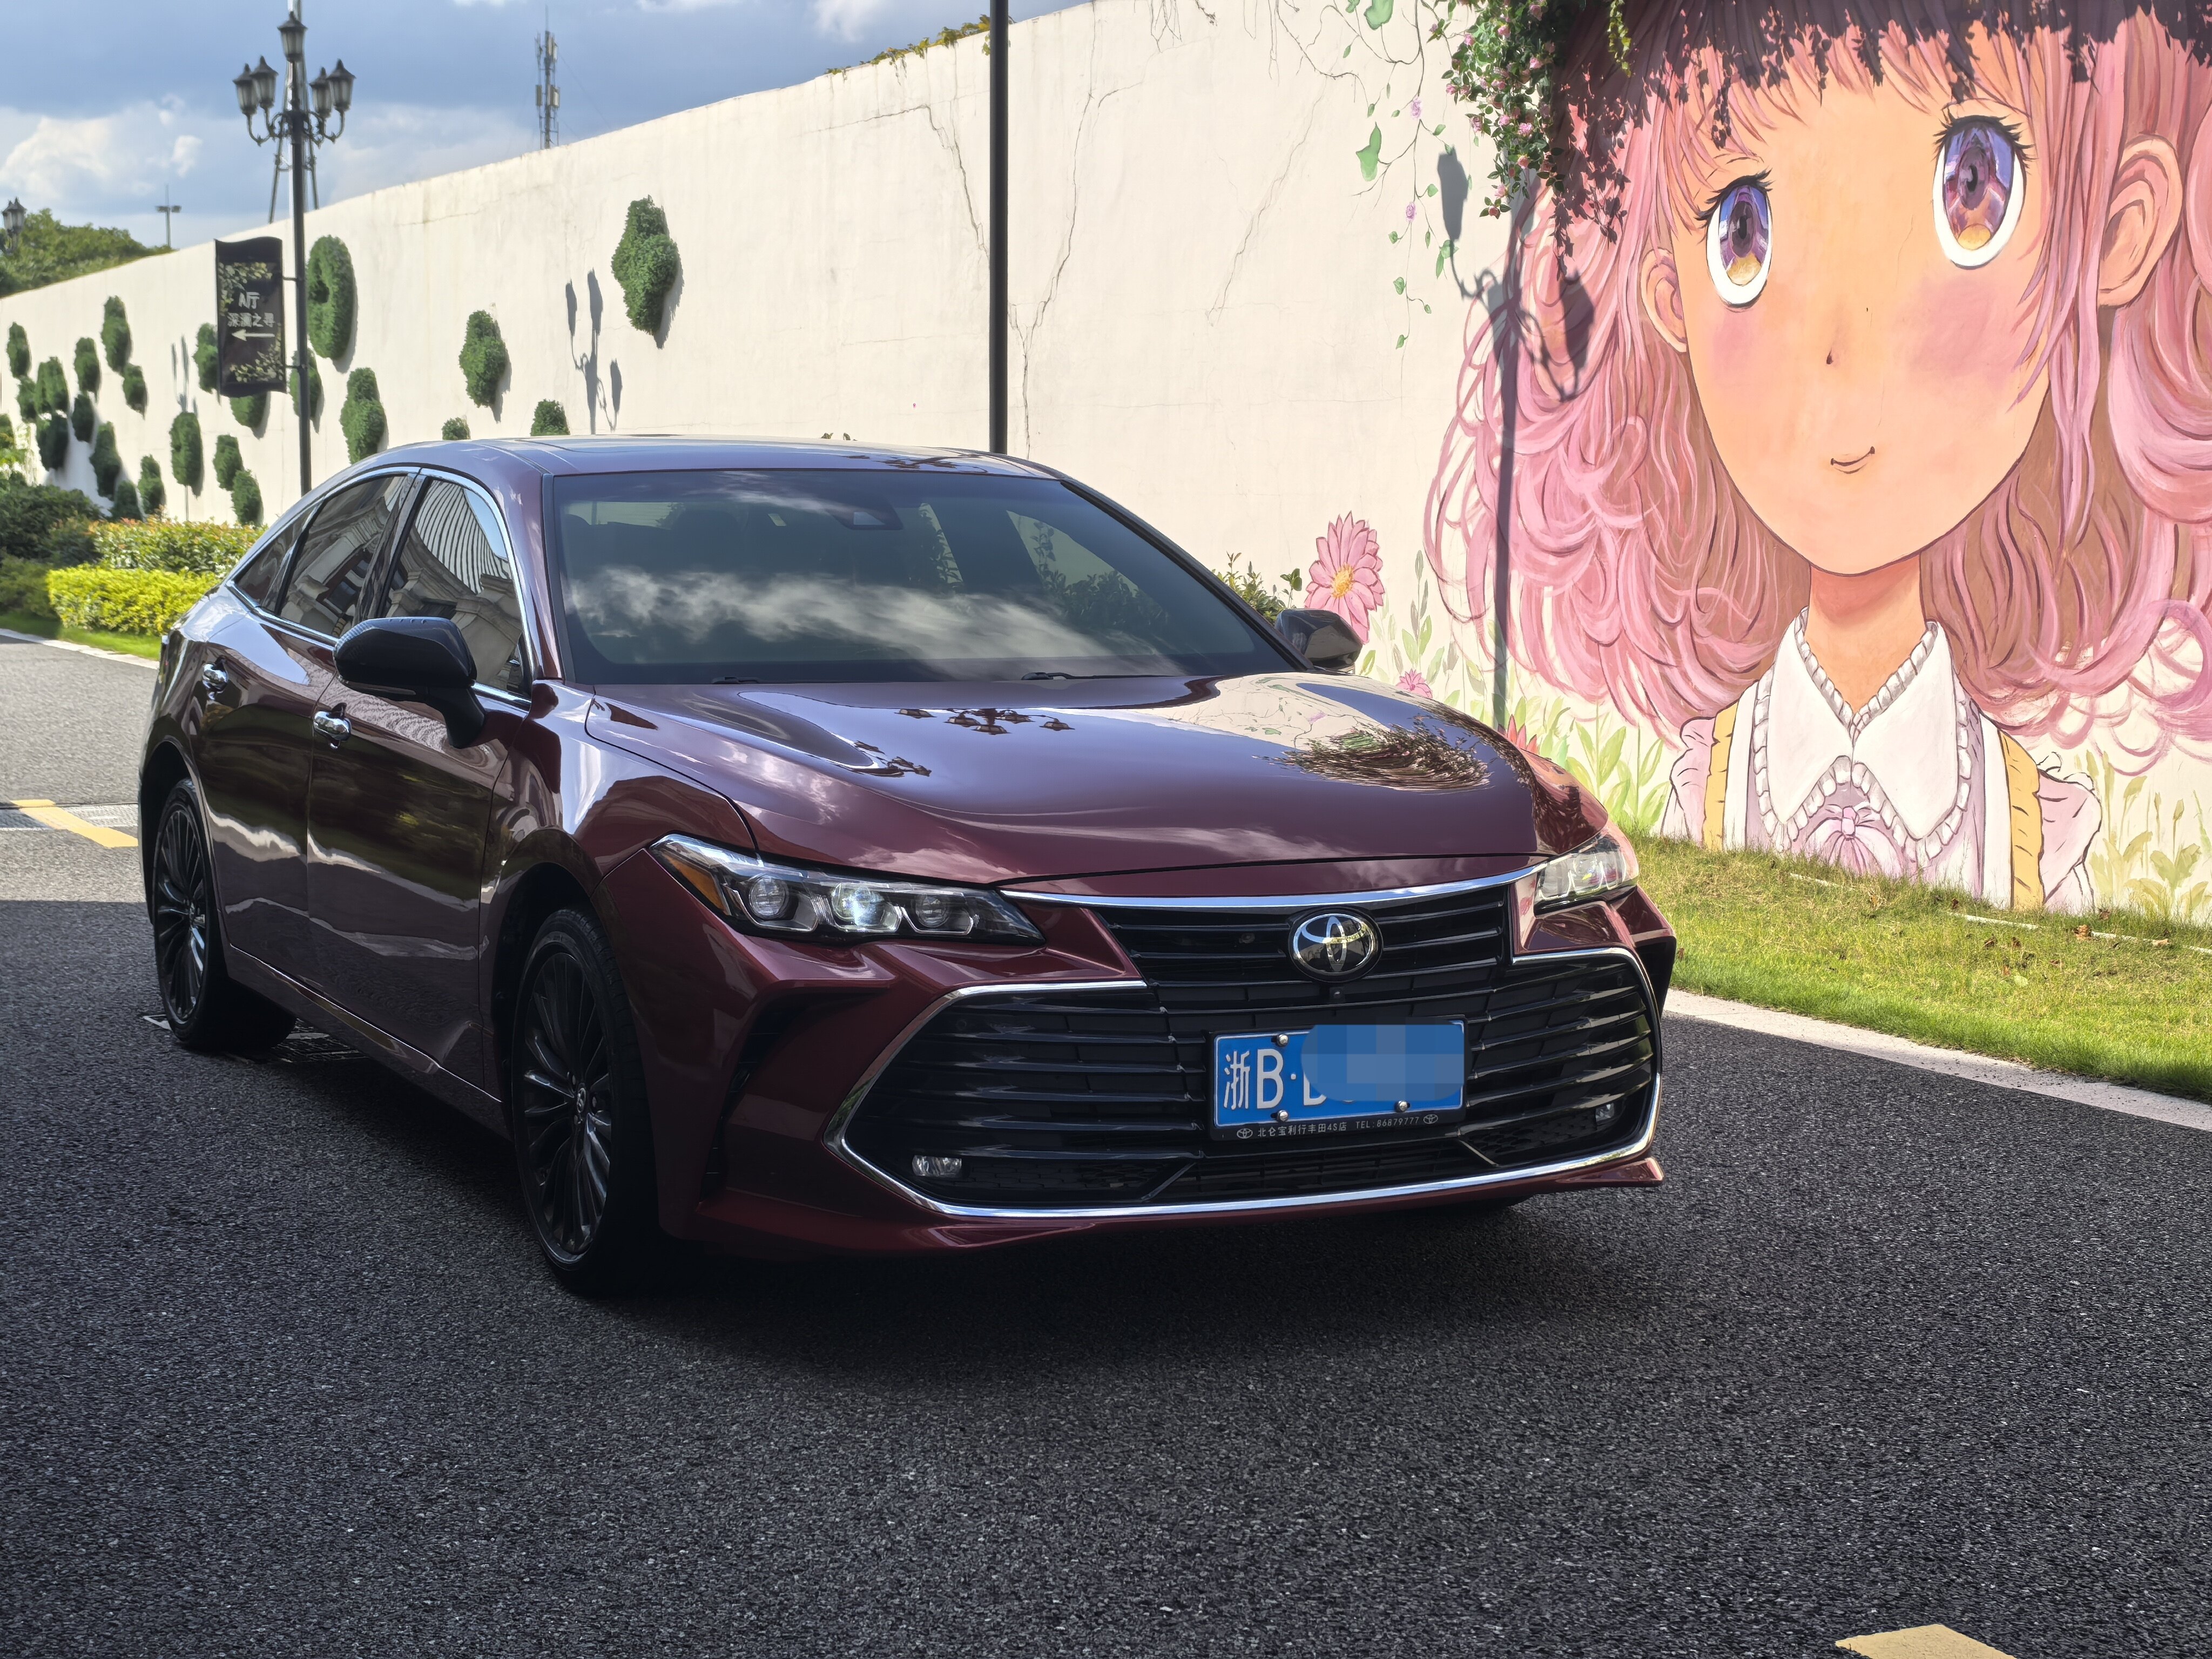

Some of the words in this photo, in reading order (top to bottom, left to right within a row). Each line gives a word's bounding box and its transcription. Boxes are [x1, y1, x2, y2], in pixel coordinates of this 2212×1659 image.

[1257, 1122, 1347, 1137] 北仑宝利行丰田4S店
